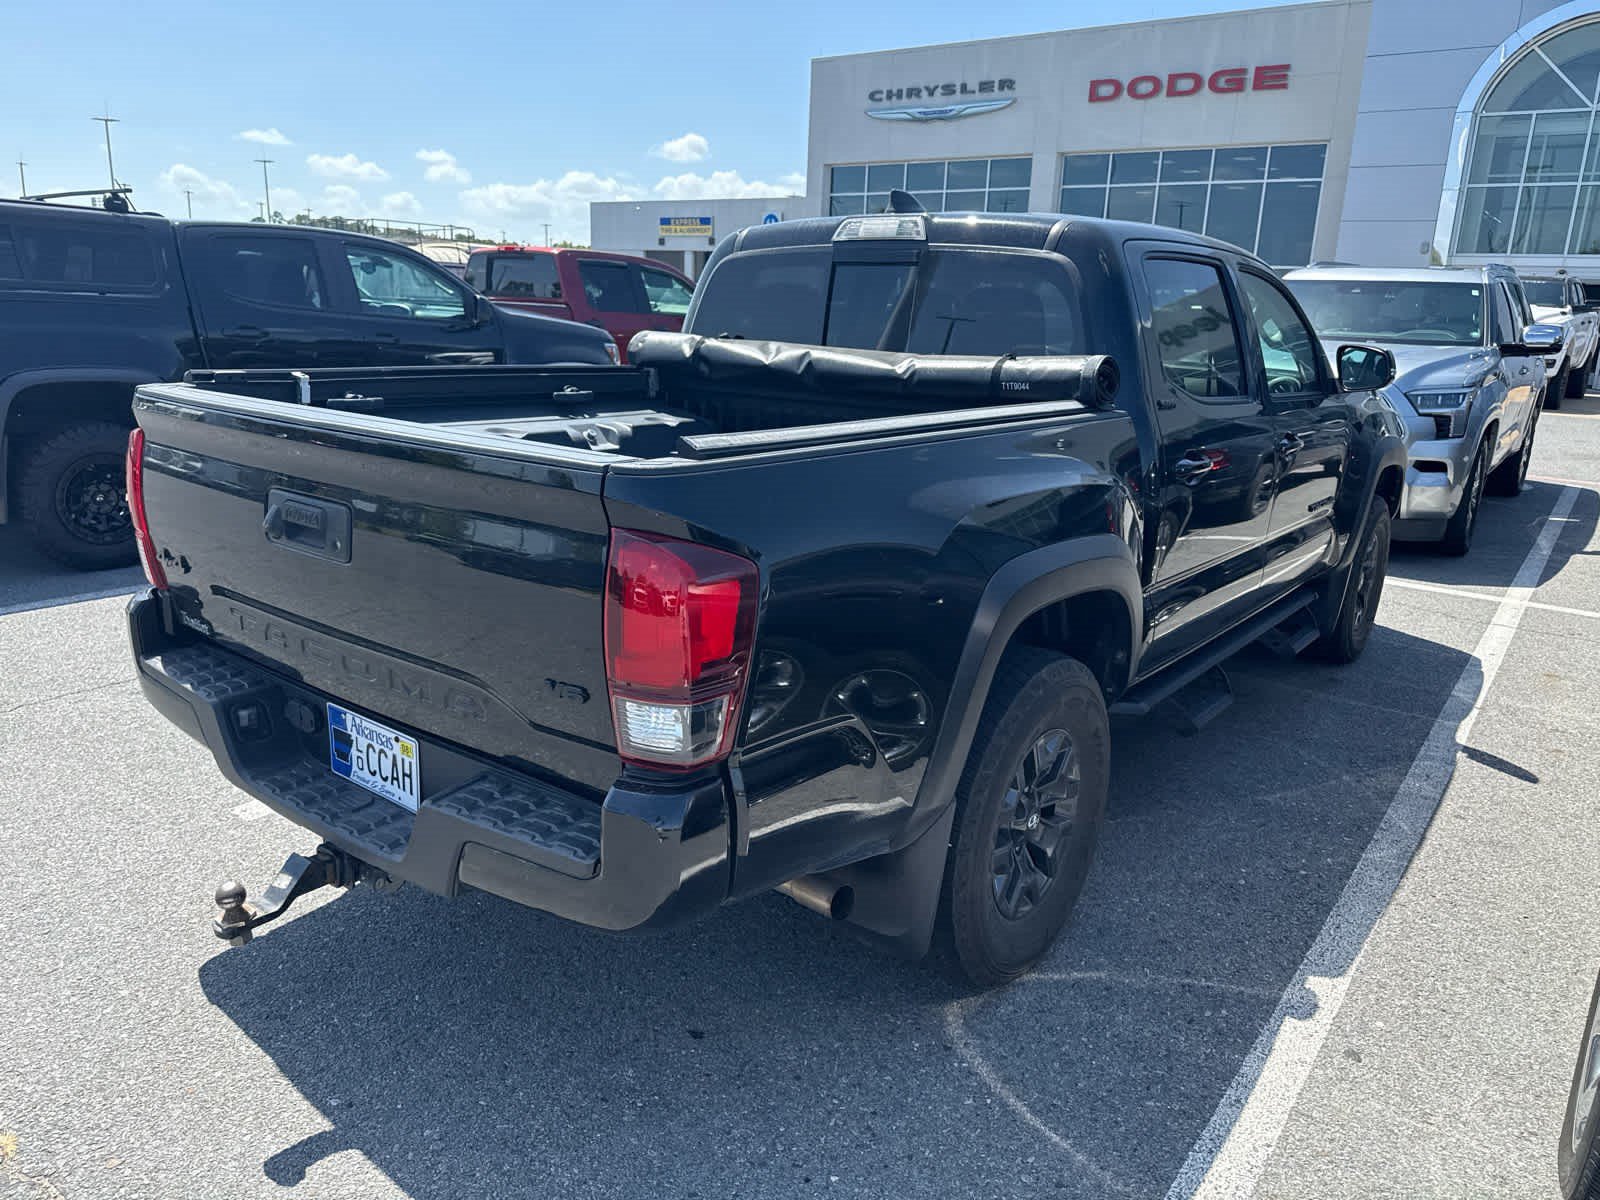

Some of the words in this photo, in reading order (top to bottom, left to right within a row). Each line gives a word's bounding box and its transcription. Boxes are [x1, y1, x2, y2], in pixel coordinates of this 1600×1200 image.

[868, 77, 1017, 103] CHRYSLER
[1087, 63, 1292, 104] DODGE
[671, 217, 700, 226] EXPRESS
[230, 607, 487, 721] TACOMA
[350, 717, 394, 751] Arkansas
